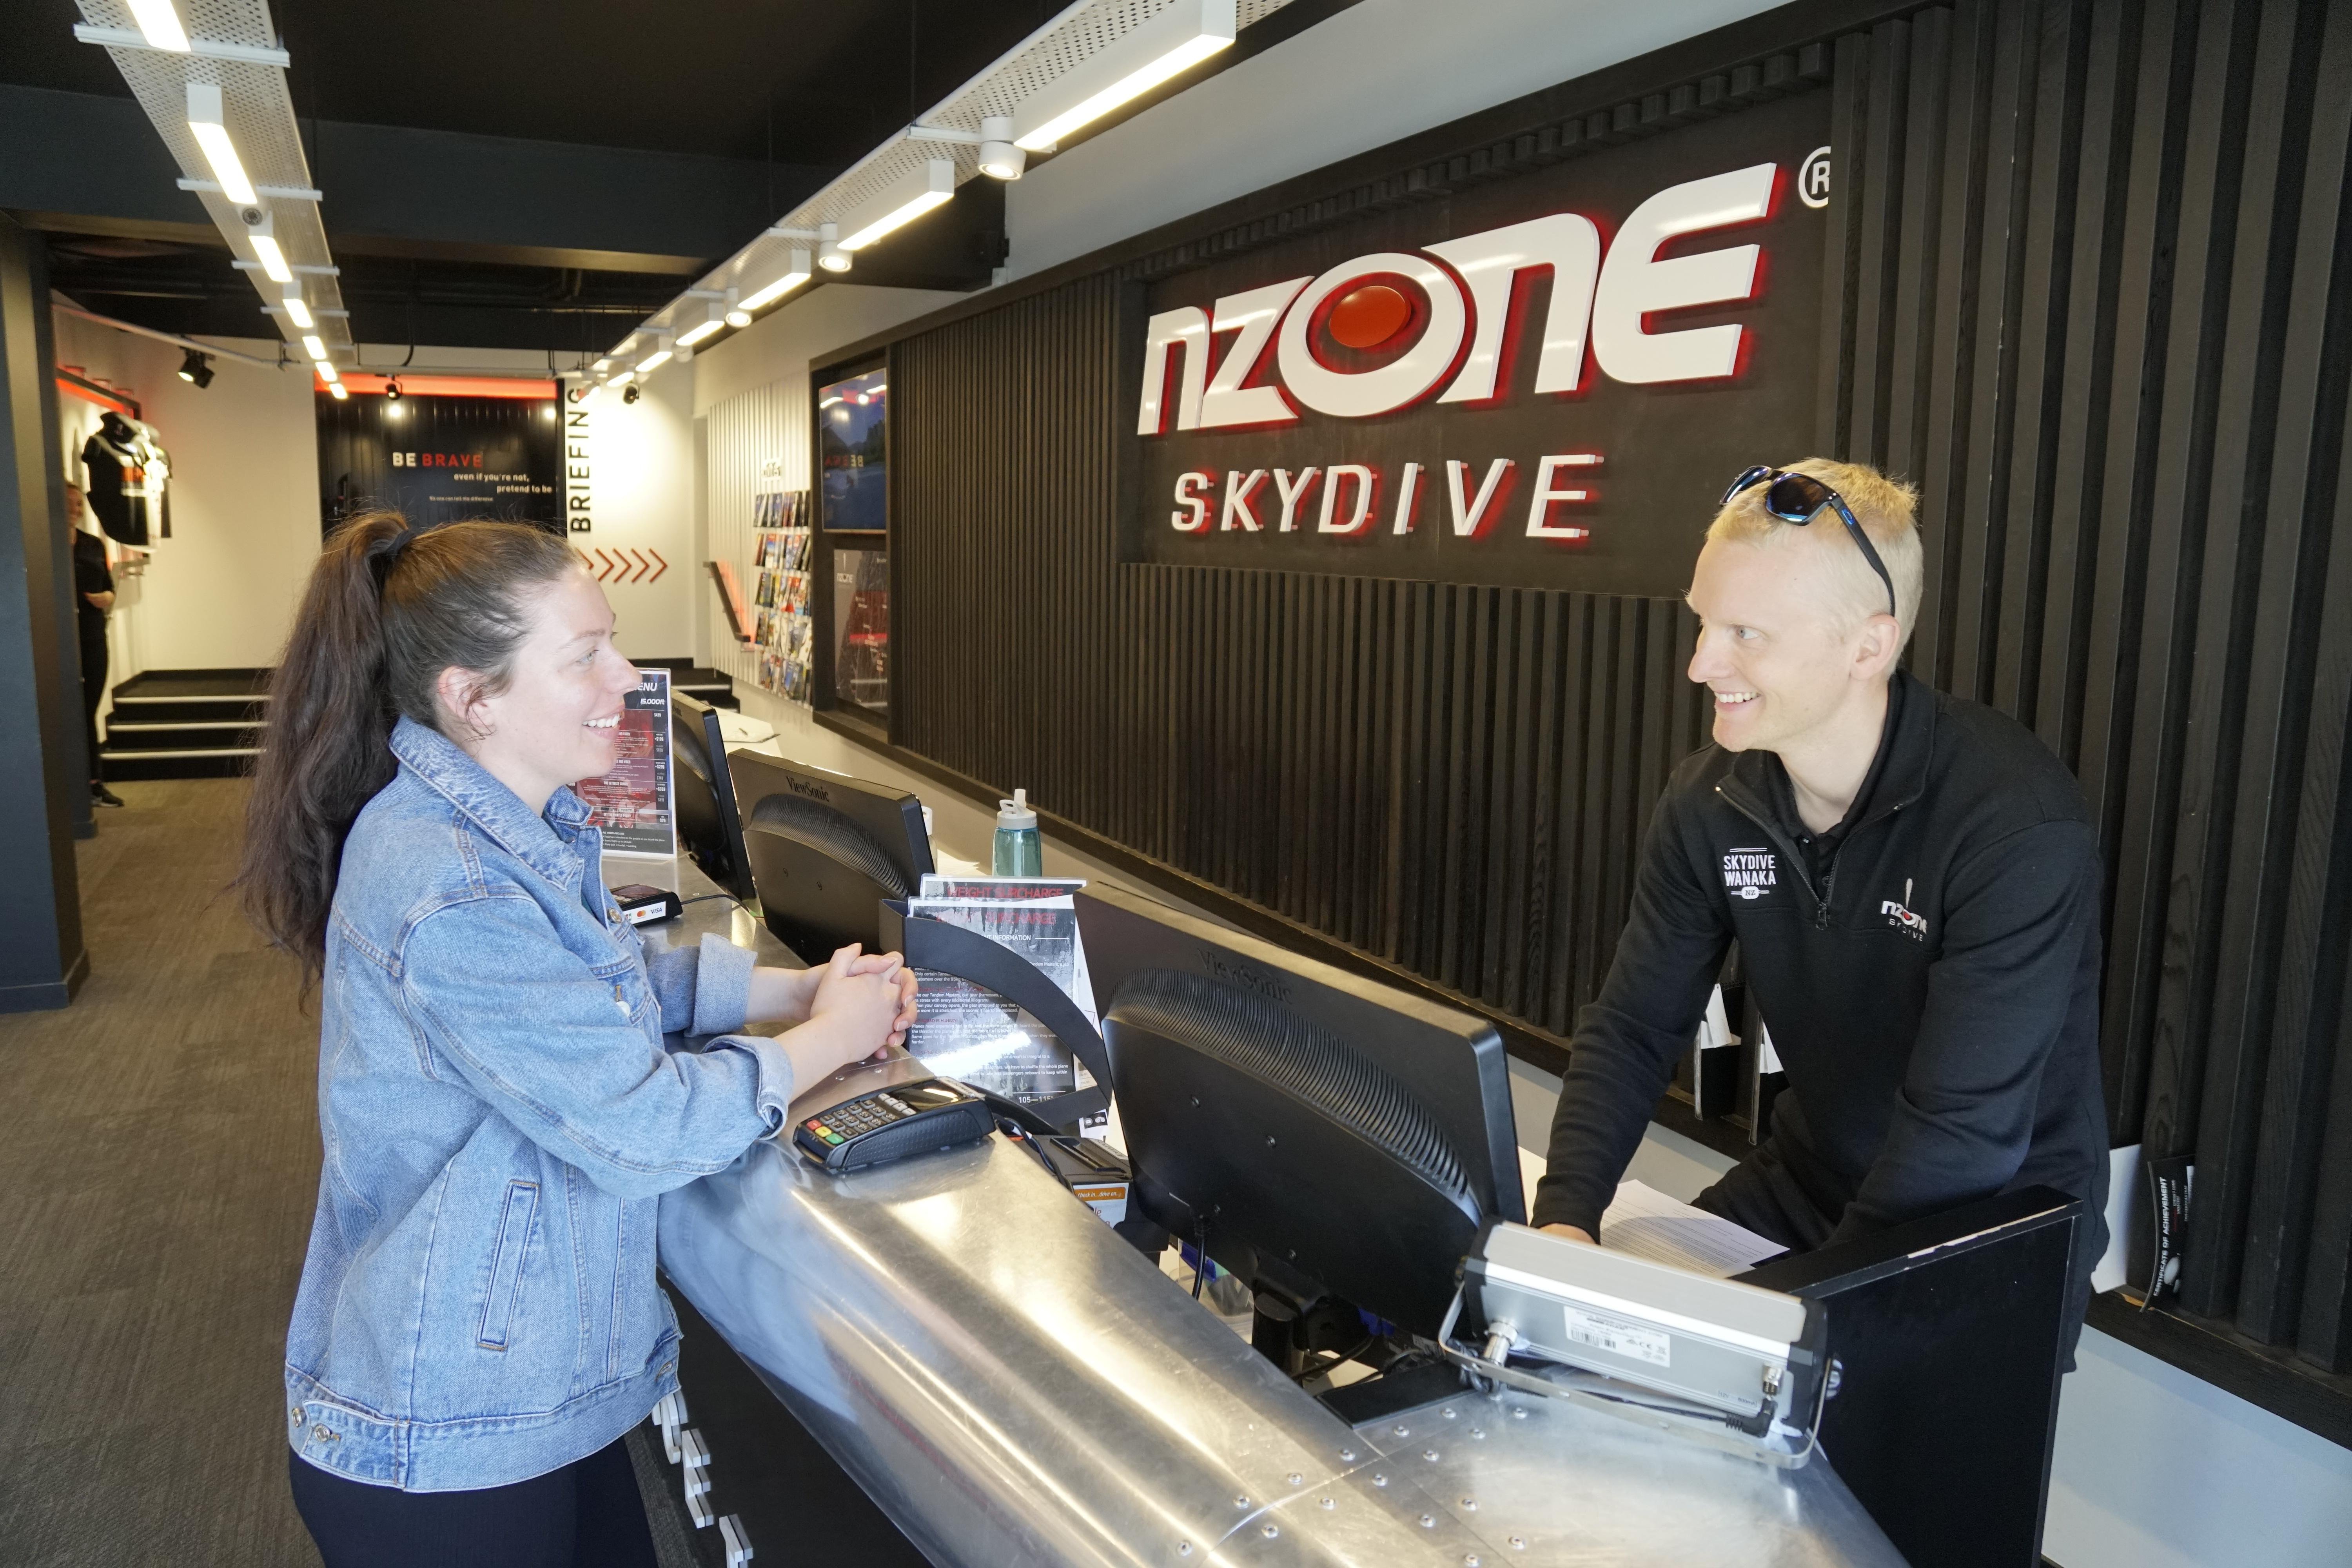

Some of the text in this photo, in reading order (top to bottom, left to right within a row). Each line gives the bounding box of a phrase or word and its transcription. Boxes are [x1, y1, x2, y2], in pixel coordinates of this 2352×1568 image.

[392, 452, 483, 468] BE BRAVE
[568, 388, 591, 533] BRIEFING
[476, 472, 483, 481] if
[483, 473, 511, 483] you're
[513, 474, 530, 482] not,
[497, 485, 530, 494] pretend
[1172, 453, 1601, 538] SKYDIVE
[635, 682, 657, 691] ENU
[785, 776, 830, 802] ViewSonic
[1724, 855, 1776, 870] SKYDIVE
[1724, 871, 1776, 886] WANAKA
[994, 887, 1064, 899] SURCHARGE
[2153, 1177, 2170, 1296] CERTIFICATE OF ACHIEVEMENT
